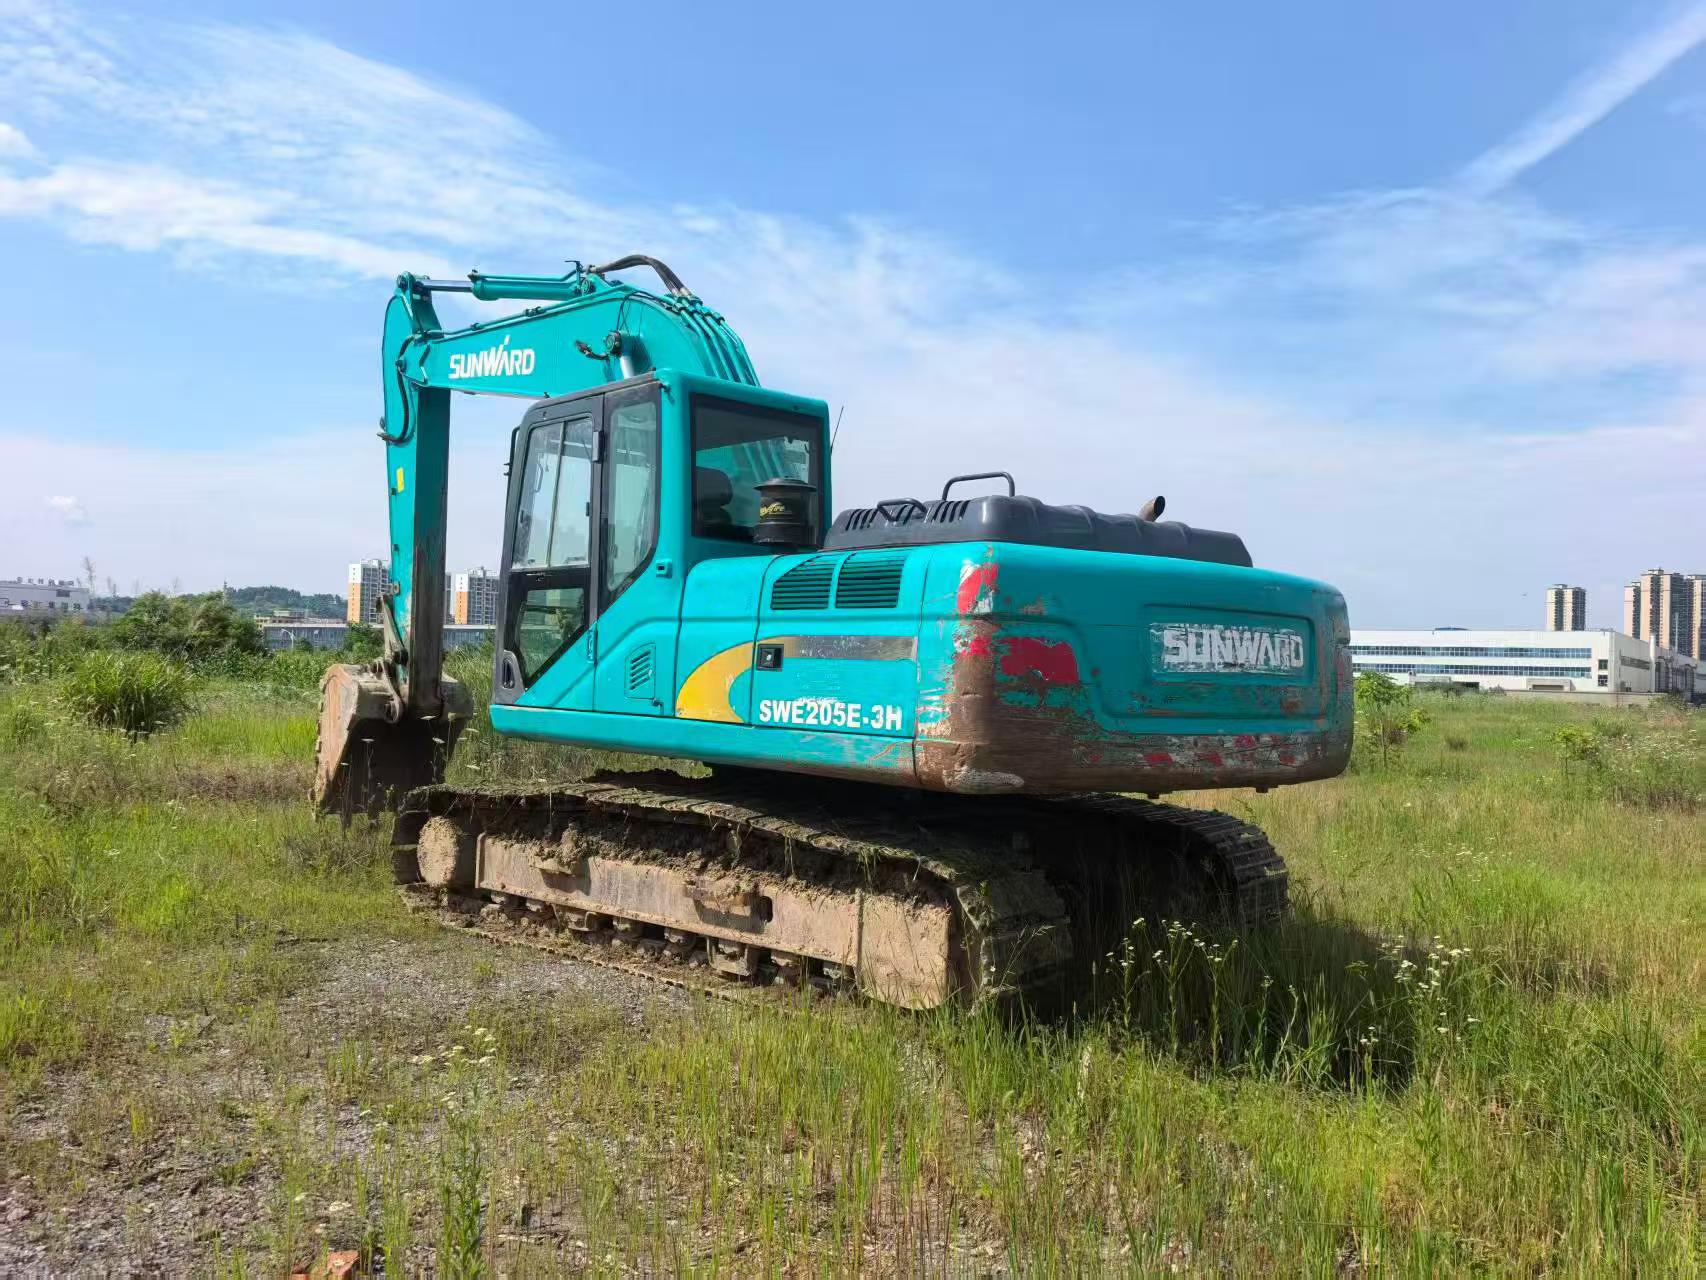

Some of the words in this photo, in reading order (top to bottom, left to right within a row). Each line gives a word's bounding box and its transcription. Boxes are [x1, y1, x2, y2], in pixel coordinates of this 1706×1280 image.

[448, 335, 536, 379] SUNWARD
[1163, 628, 1304, 668] SUNWARD
[759, 699, 903, 731] SWE205E-3H
